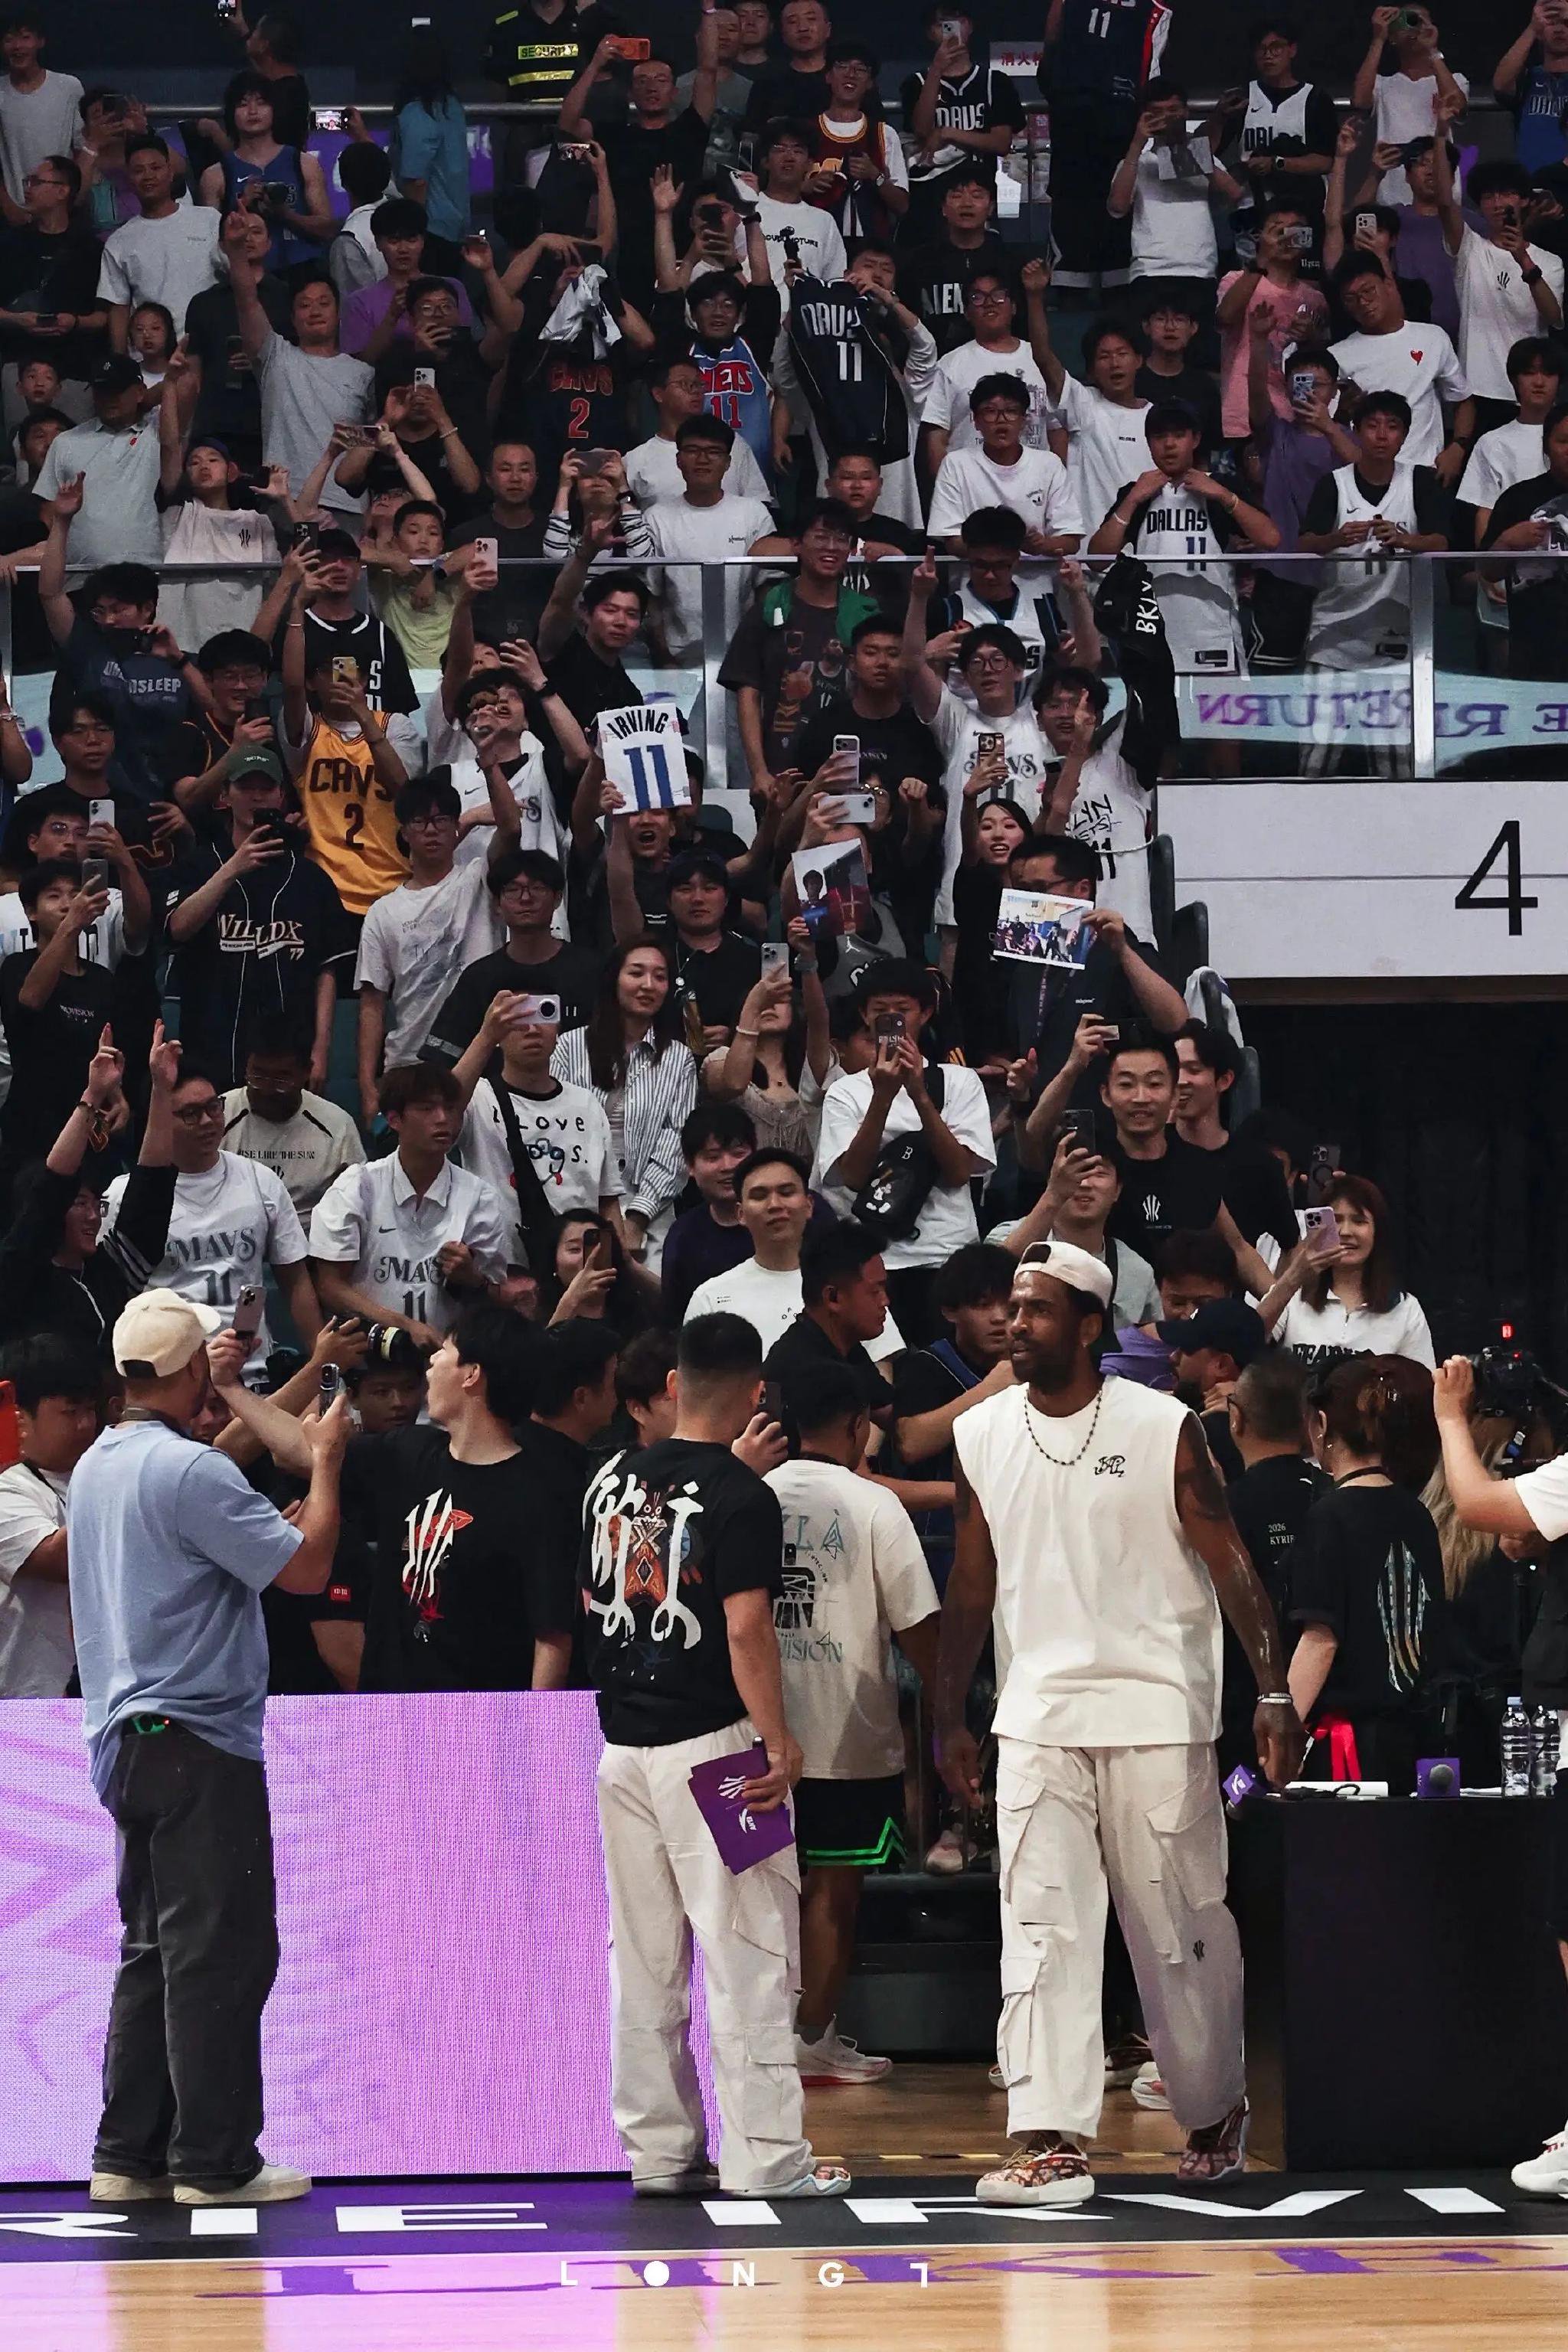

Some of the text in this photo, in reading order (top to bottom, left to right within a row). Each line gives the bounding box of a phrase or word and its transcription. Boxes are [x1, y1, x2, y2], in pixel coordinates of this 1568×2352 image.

[1088, 7, 1111, 39] 11
[837, 341, 863, 382] 11
[568, 397, 590, 439] 2
[710, 394, 743, 430] 11
[1147, 508, 1207, 534] DALLAS
[1186, 537, 1207, 571] 11
[606, 709, 669, 740] IRVING
[624, 743, 675, 809] 11
[345, 803, 364, 851] 2
[1455, 820, 1538, 936] 4
[205, 1269, 233, 1307] 11
[403, 1290, 426, 1325] 11
[700, 2187, 1568, 2226] IRVI
